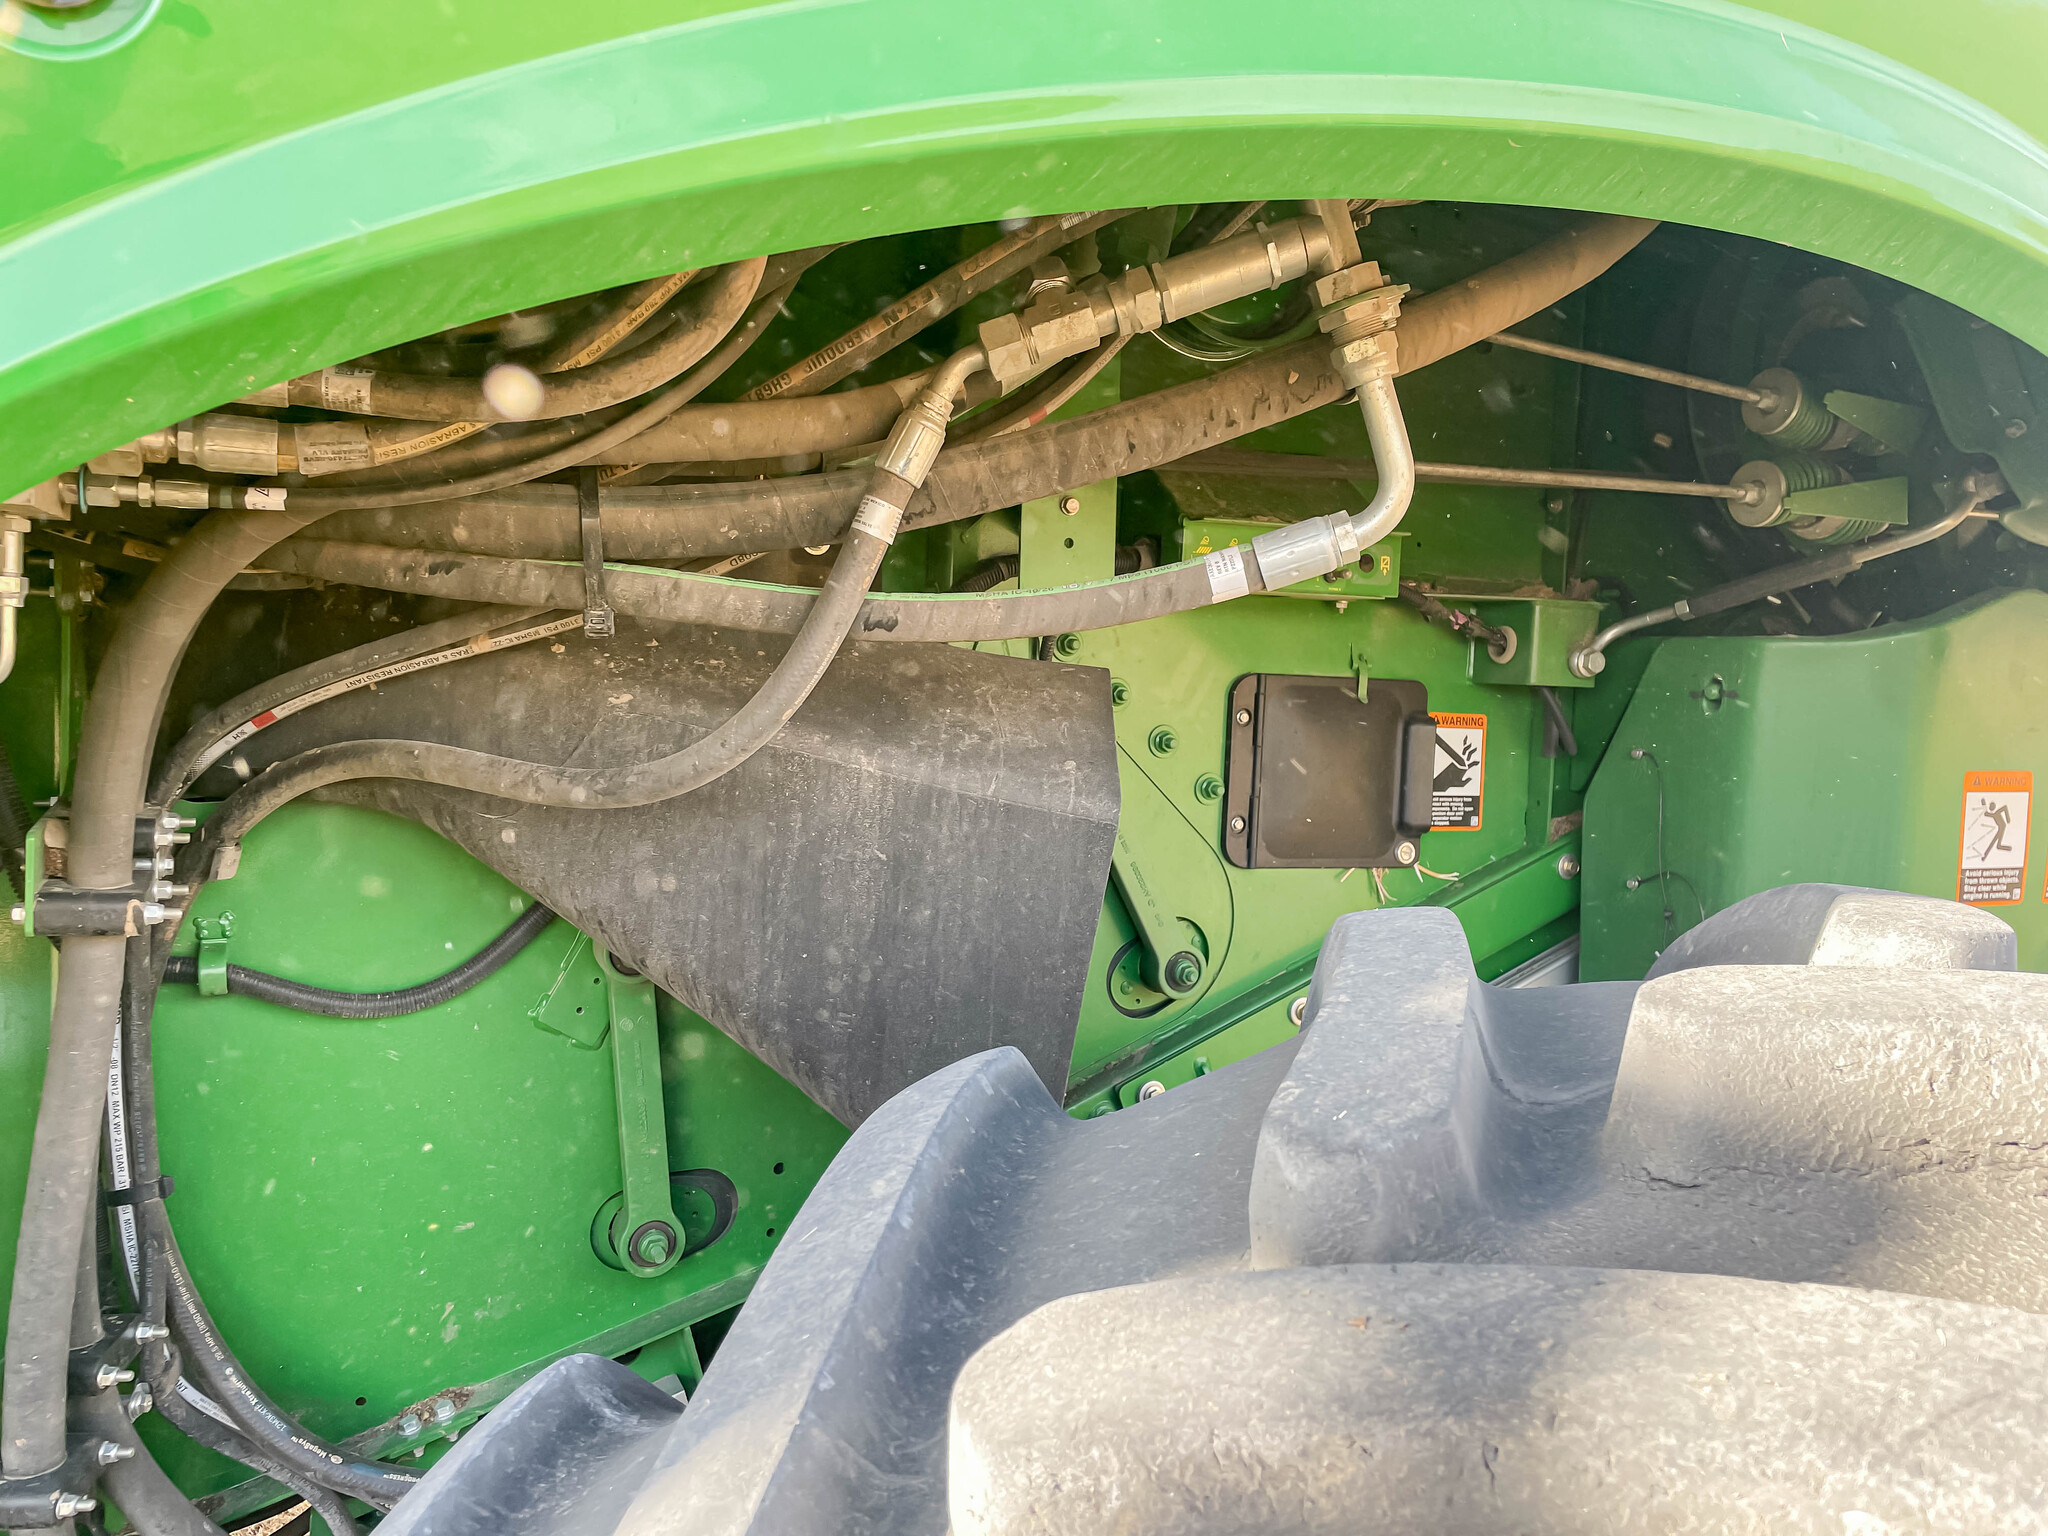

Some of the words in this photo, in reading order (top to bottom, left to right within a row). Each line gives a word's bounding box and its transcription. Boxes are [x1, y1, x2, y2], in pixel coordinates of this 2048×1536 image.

[656, 285, 673, 301] WP
[623, 308, 645, 329] BAR
[584, 343, 602, 360] PSI
[408, 423, 467, 457] ABRASION
[541, 621, 559, 635] PSI
[558, 615, 580, 630] 3100
[513, 626, 541, 643] MSHA
[391, 651, 441, 677] ABRASION
[343, 665, 394, 691] RESISTANT
[1441, 717, 1484, 727] WARNING
[1985, 776, 2026, 786] WARNING
[2004, 870, 2019, 878] injury
[1963, 892, 1982, 901] engine
[1964, 885, 1977, 893] Stay
[109, 1073, 119, 1096] DN12
[111, 1099, 121, 1121] MAX
[112, 1120, 122, 1136] WP
[113, 1137, 123, 1153] 215
[114, 1153, 124, 1173] BAR
[122, 1218, 135, 1244] MSHA
[184, 1297, 198, 1315] PSI)
[189, 1311, 210, 1334] (3250
[201, 1330, 217, 1347] MPa
[209, 1344, 225, 1361] 22.5
[228, 1373, 259, 1406] XtraTuff™
[290, 1432, 328, 1458] MegaSys™
